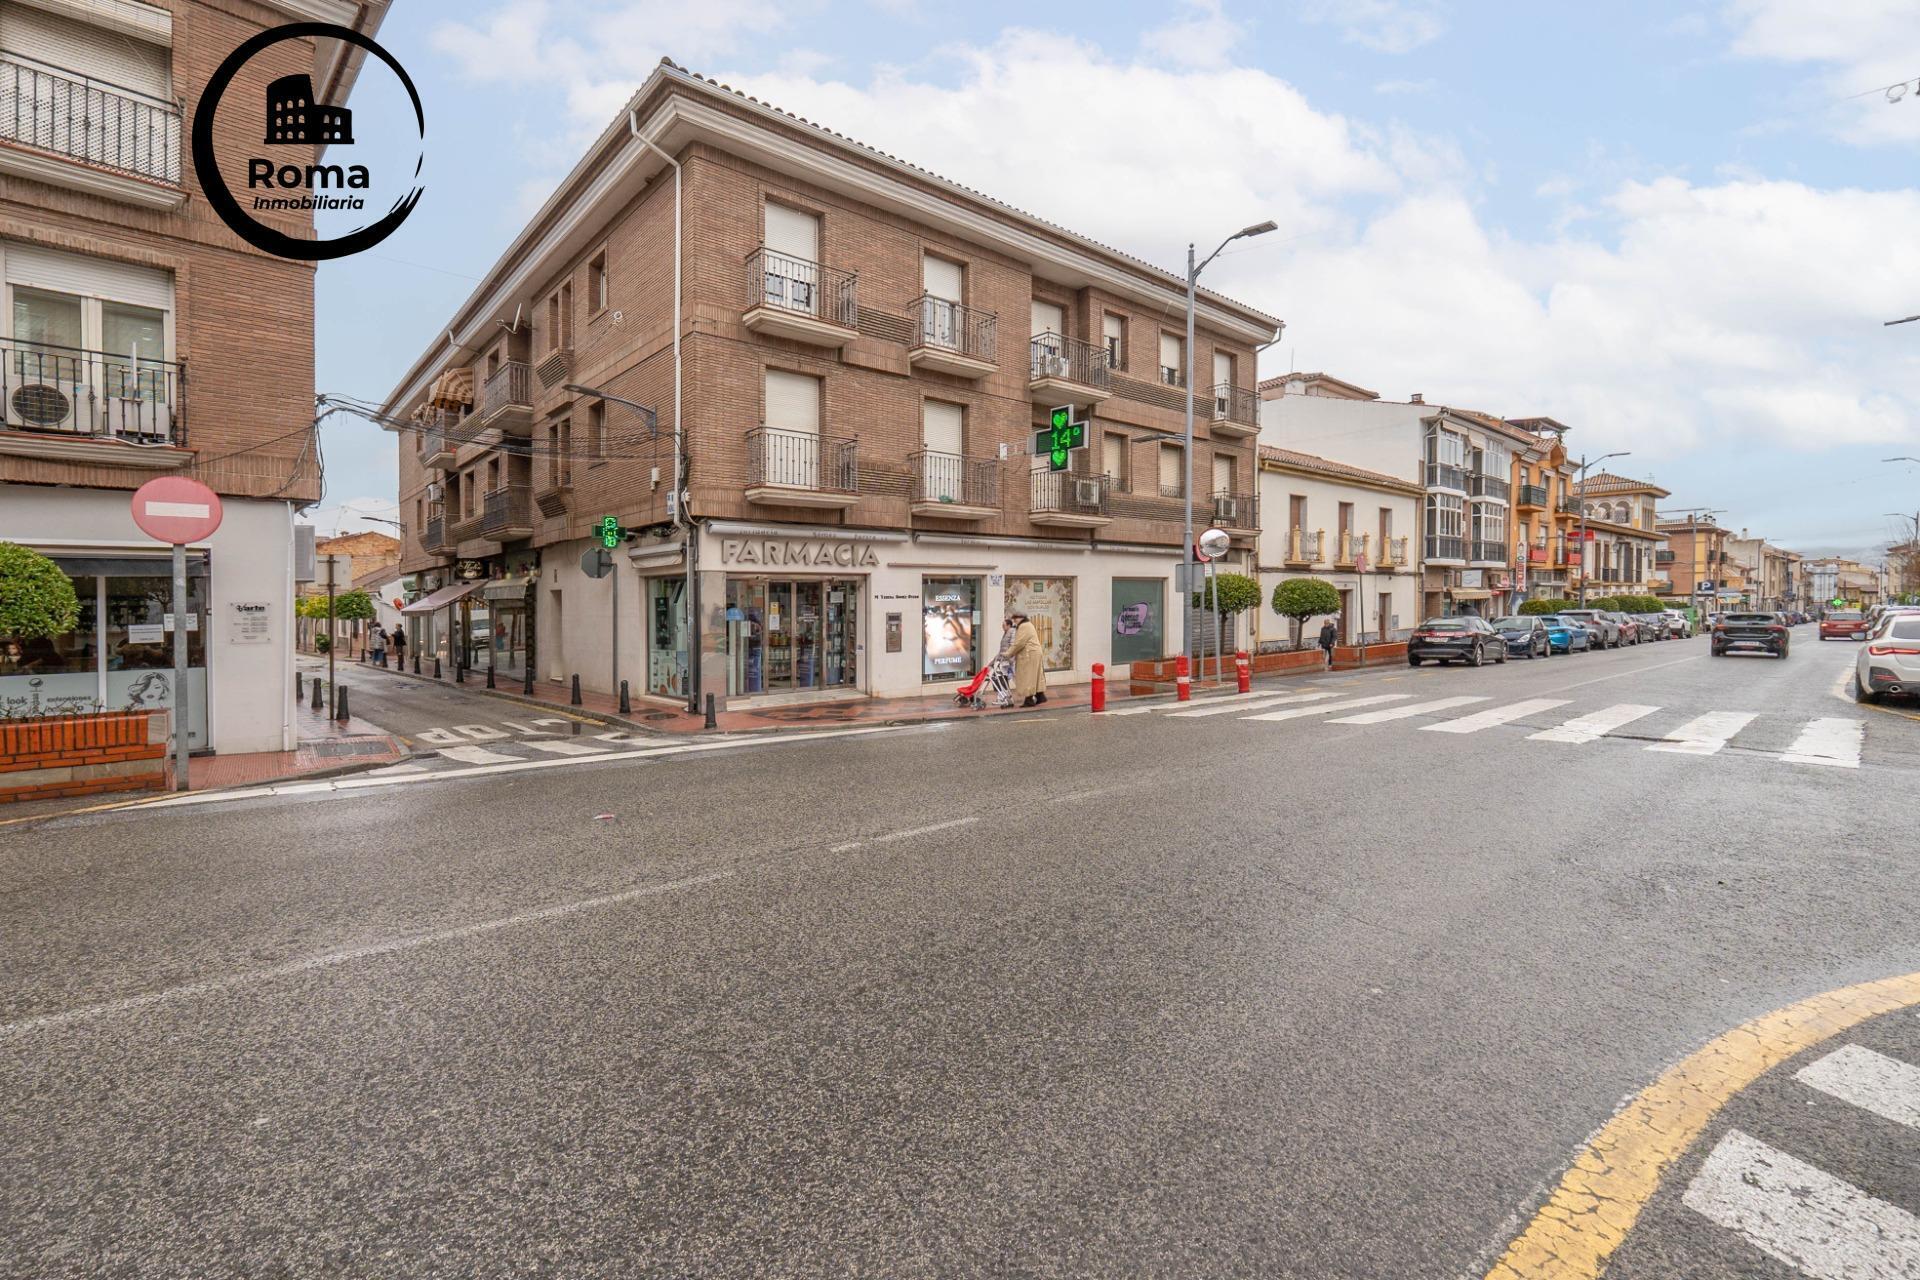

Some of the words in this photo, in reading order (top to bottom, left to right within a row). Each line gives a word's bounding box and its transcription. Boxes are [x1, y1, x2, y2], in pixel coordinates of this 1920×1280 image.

[722, 539, 880, 567] FARMACIA
[935, 656, 962, 664] PERFUME
[7, 696, 28, 705] look
[47, 695, 92, 703] extensiones
